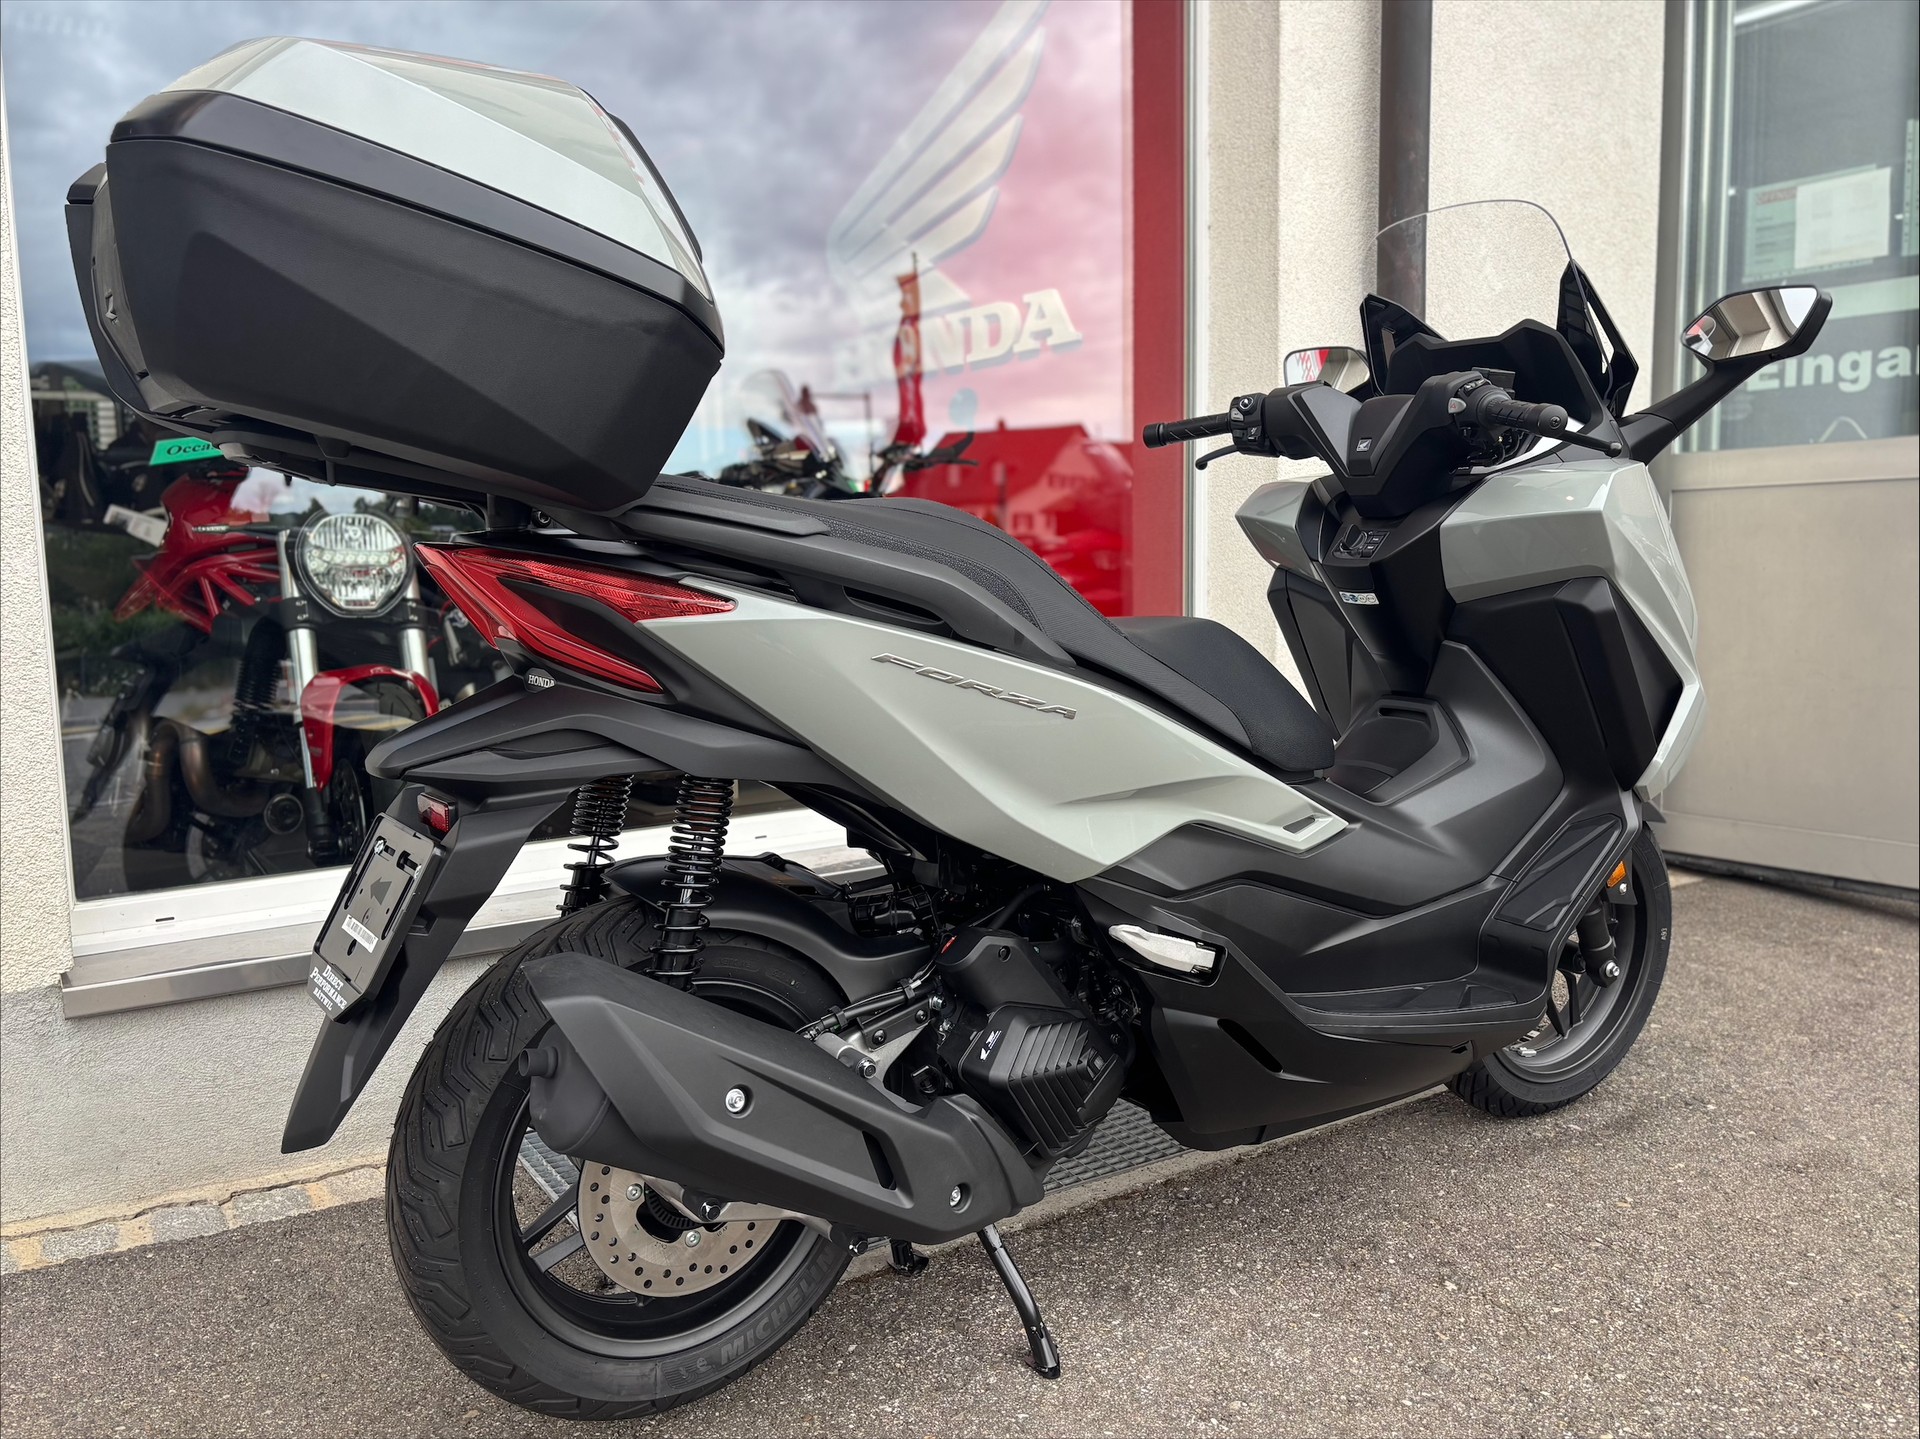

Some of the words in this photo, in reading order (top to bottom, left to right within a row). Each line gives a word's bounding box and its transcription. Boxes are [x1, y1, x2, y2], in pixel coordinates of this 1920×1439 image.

[1746, 344, 1918, 393] Einga
[167, 443, 214, 456] Occa
[528, 674, 555, 688] HONDA
[871, 652, 1077, 720] FORZA
[309, 966, 348, 1010] PERFORMANCE
[322, 965, 344, 991] DIRECT
[720, 1249, 834, 1366] MICHELIN
